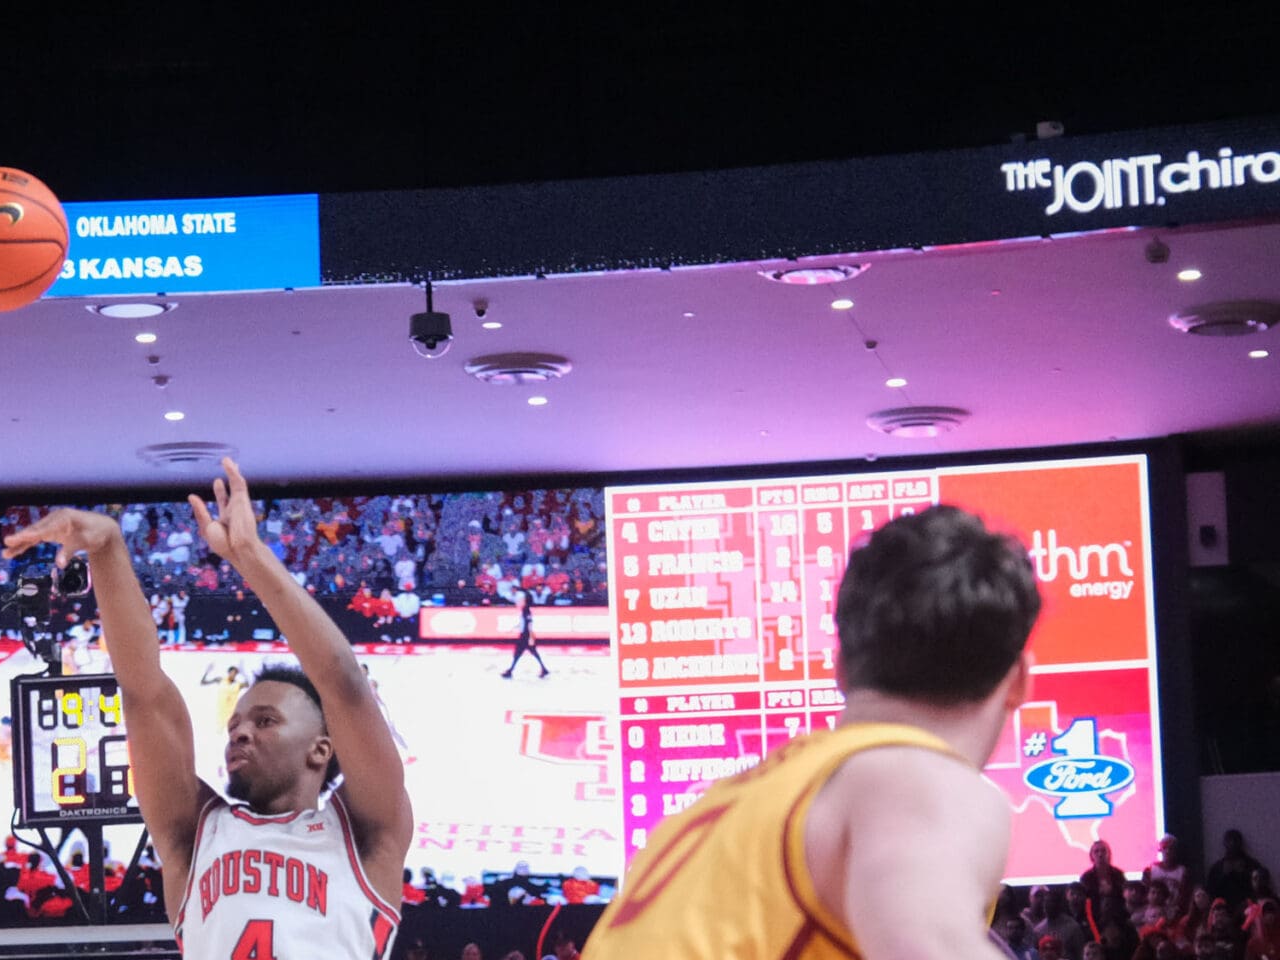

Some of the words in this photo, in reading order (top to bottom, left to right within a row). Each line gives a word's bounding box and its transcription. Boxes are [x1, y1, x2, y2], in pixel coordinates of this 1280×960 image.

[1001, 159, 1052, 191] THE
[76, 214, 178, 237] OKLAHOMA
[182, 211, 237, 234] STATE
[79, 255, 203, 280] KANSAS
[659, 494, 726, 510] PLAYER
[622, 522, 638, 543] 4
[861, 510, 874, 530] 1
[624, 589, 639, 610] 7
[820, 580, 833, 601] 1
[1069, 580, 1134, 600] energy
[821, 648, 834, 669] 1
[667, 694, 735, 711] PLAYER
[768, 691, 803, 707] PTS
[628, 726, 644, 748] 0
[784, 717, 800, 738] 7
[1043, 760, 1114, 791] Ford
[60, 807, 128, 817] DAKTRONICS
[199, 850, 329, 922] HOUSTON
